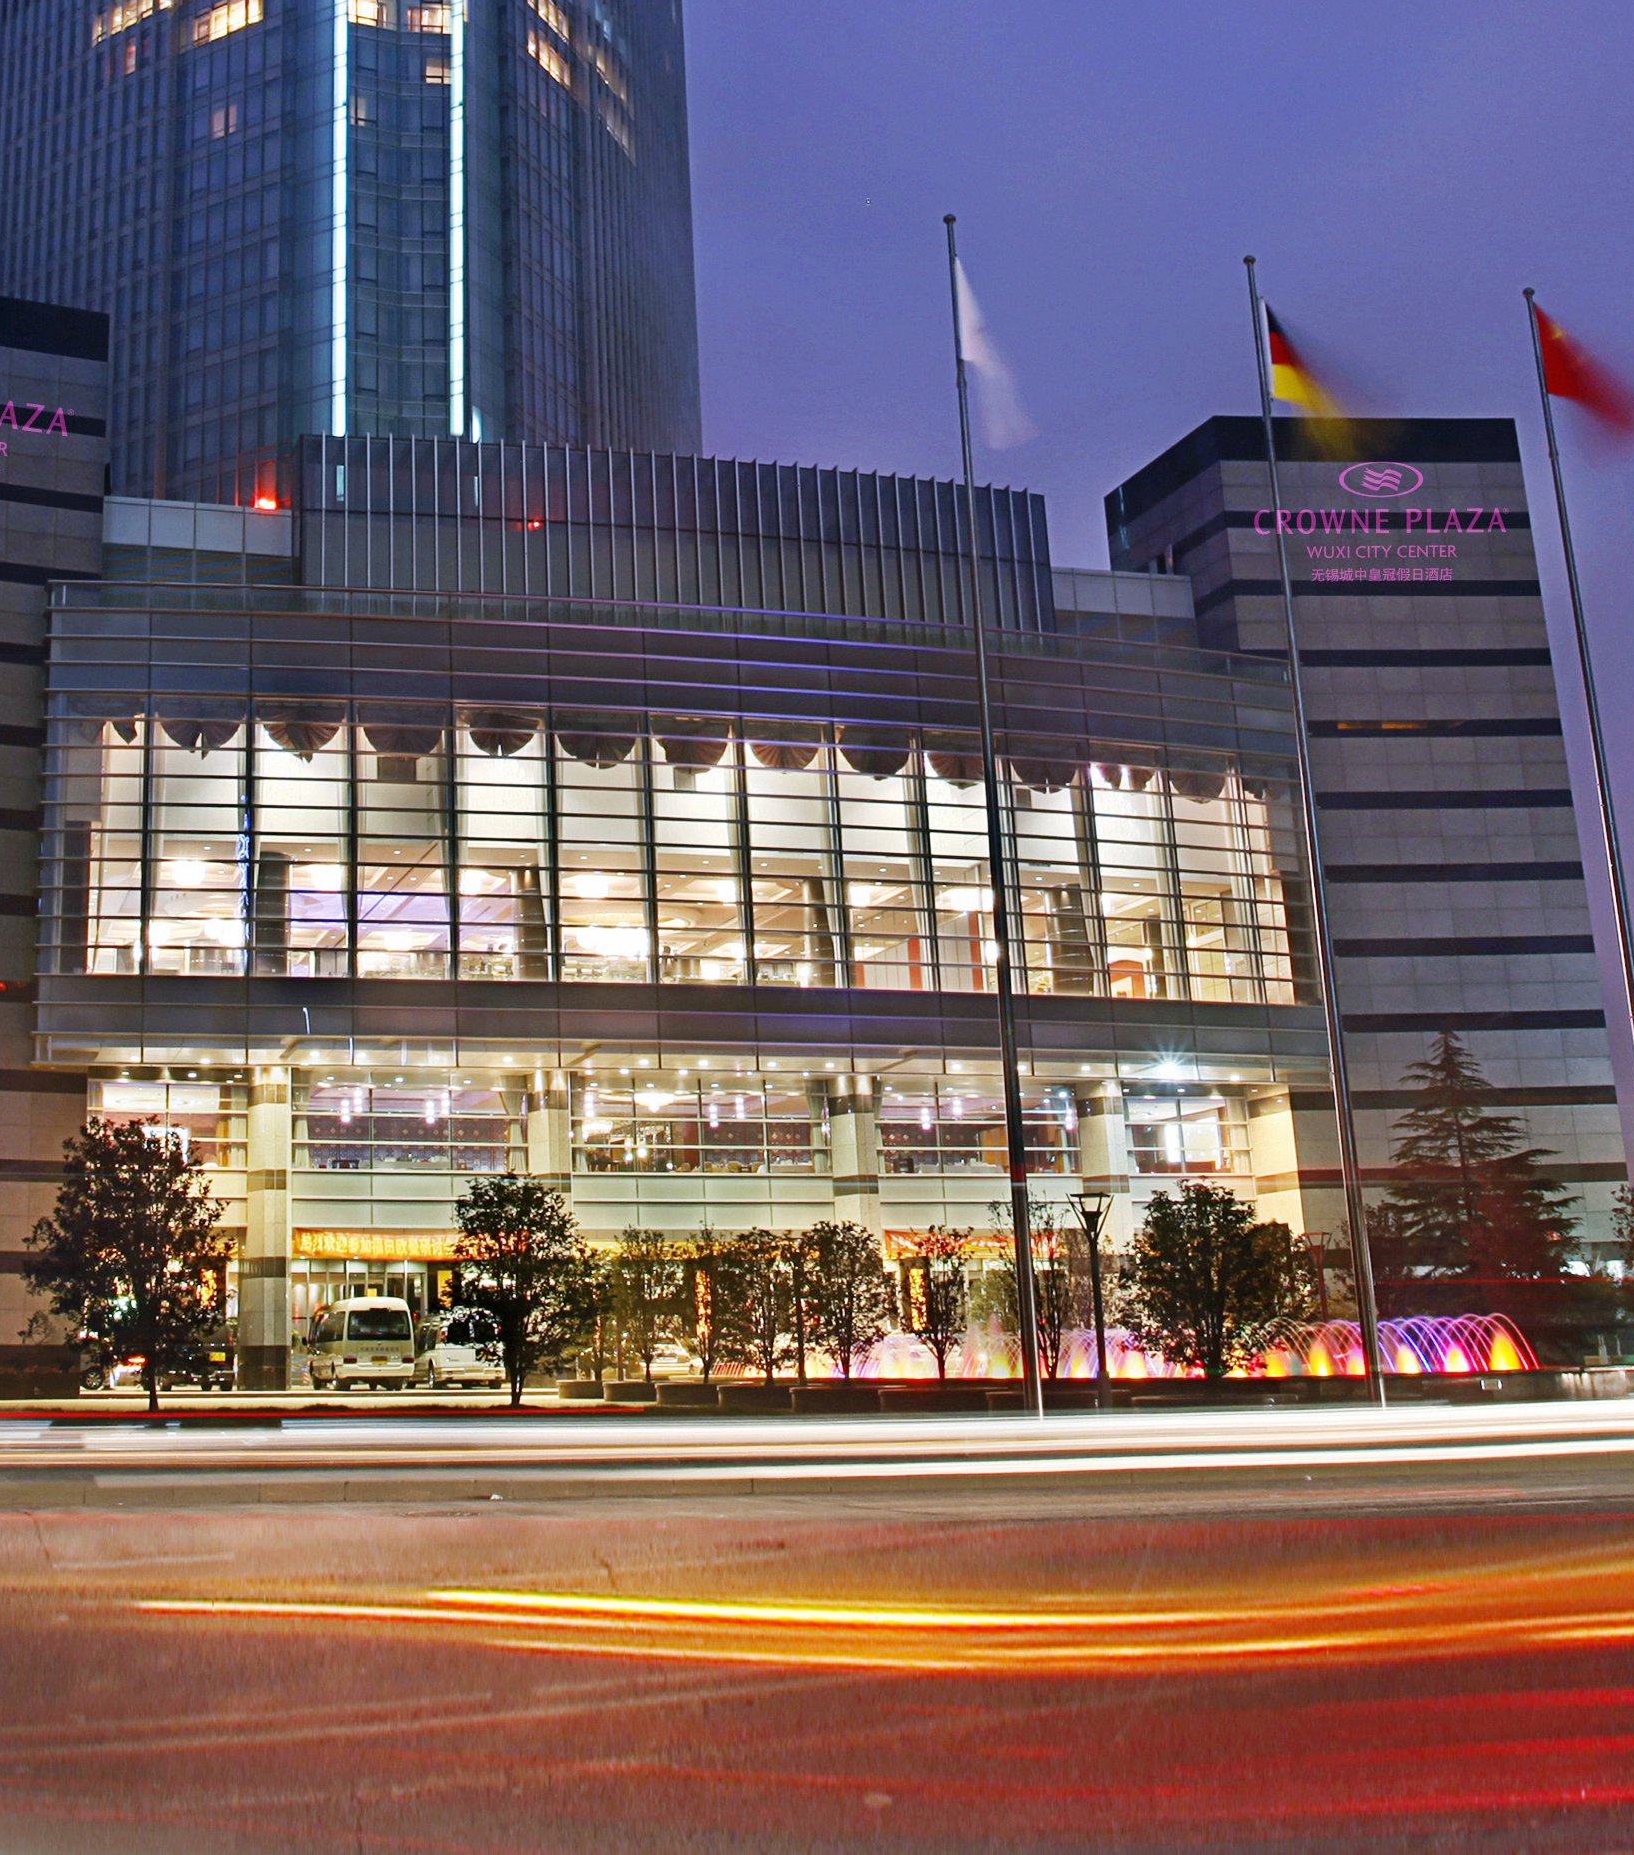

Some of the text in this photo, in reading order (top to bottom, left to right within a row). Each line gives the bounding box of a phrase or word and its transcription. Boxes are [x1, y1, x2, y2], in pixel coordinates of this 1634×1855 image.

[1253, 508, 1390, 536] CROWNE
[1307, 544, 1458, 559] WUXI CITY CENTER
[1311, 567, 1453, 583] 无锡城中皇冠假日酒店
